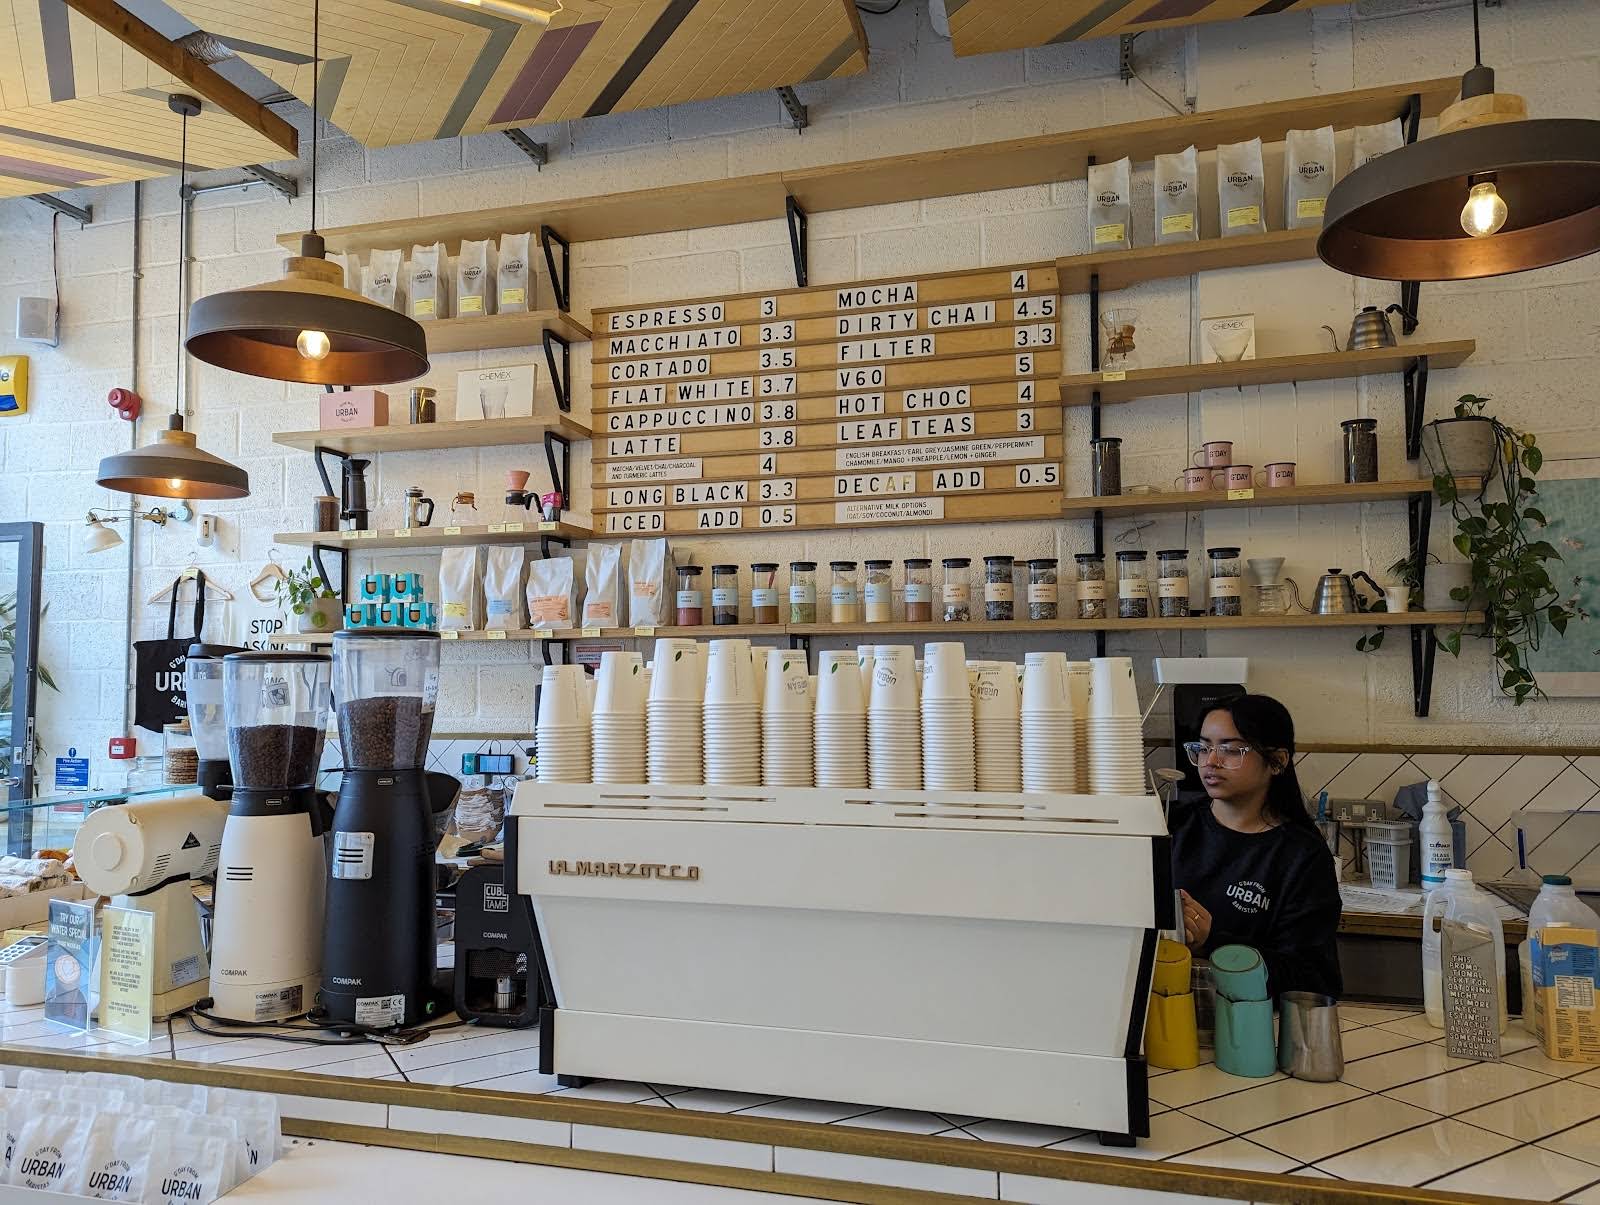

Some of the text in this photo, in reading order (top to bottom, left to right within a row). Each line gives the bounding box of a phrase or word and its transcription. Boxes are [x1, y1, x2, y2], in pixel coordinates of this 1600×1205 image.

[1298, 165, 1325, 174] URBAN
[1227, 174, 1253, 183] URBAN
[1163, 182, 1188, 192] URBAN
[1096, 194, 1120, 203] URBAN
[839, 274, 1025, 308] MOCHA 4
[611, 300, 774, 330] ESPRESSO 3
[840, 299, 1053, 335] DIRTY CHAI 4.5
[611, 325, 793, 355] MACCHIATO 3.3
[841, 328, 1052, 361] FILTER 3.3
[611, 352, 793, 380] CORTADO 3.5
[840, 357, 1031, 387] V60 5
[479, 371, 512, 380] CHEMEX
[612, 377, 794, 405] FLAT WHITE 3.7
[839, 385, 1032, 414] HOT CHOC 4
[336, 408, 358, 416] URBAN
[611, 405, 794, 430] CAPPUCCINO 3.8
[841, 413, 1031, 441] LEAF TEAS 3
[611, 430, 794, 455] LATTE 3.8
[845, 451, 870, 459] ENGLISH
[1209, 450, 1227, 458] G'DAY
[762, 457, 773, 472] 4
[838, 466, 1056, 494] DECAF ADD 0.5
[1186, 476, 1204, 484] G'DAY
[1275, 470, 1294, 478] G'DAY
[611, 482, 793, 506] LONG BLACK 3.3
[846, 503, 882, 512] ALTERNATIVE
[612, 508, 793, 531] ICED ADD 0.5
[251, 619, 283, 634] STOP
[576, 861, 699, 880] MARZOCCO
[1226, 884, 1271, 911] URBAN
[486, 899, 507, 910] TAMP
[60, 912, 80, 925] TRY OUR
[51, 924, 87, 938] WINTER SPECIAL
[483, 931, 508, 940] COMPAK
[1452, 955, 1471, 963] THIS
[221, 968, 248, 977] COMPAK
[1452, 969, 1482, 979] TIONAL
[332, 976, 362, 986] COMPAK
[1448, 976, 1469, 984] TEXT
[1448, 983, 1491, 994] OAT DRINK
[255, 992, 278, 1000] COMPAK
[1450, 991, 1477, 1000] MIGHT
[356, 1000, 380, 1008] COMPAK
[1467, 1000, 1490, 1009] MORE
[1449, 1011, 1480, 1021] ESTING
[1450, 1025, 1470, 1034] ALLY
[1449, 1032, 1497, 1045] SOMETHING
[1451, 1047, 1467, 1055] OAT
[1458, 1041, 1485, 1050] ABOUT
[50, 1145, 62, 1159] FROM
[20, 1157, 66, 1180] URBAN
[120, 1160, 131, 1172] FROM
[186, 1166, 199, 1179] FROM
[88, 1171, 133, 1193] URBAN
[161, 1177, 203, 1201] URBAN
